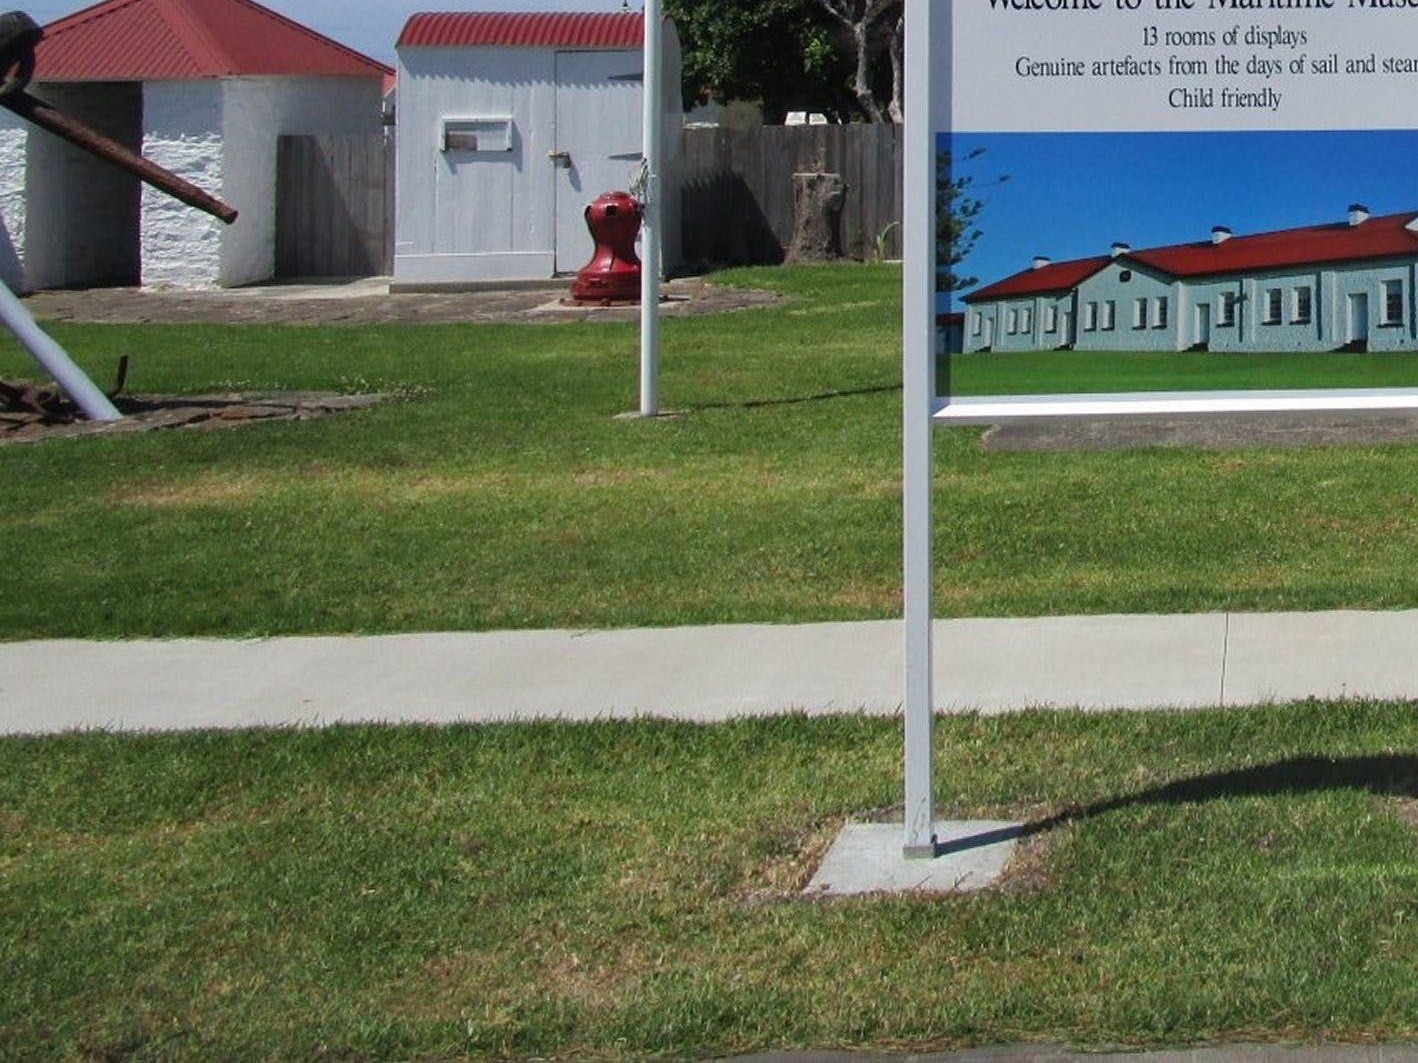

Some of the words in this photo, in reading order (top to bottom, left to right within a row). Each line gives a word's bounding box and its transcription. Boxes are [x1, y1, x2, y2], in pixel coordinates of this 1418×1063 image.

[1142, 26, 1158, 47] 13
[1165, 30, 1216, 46] rooms
[1222, 25, 1241, 47] of
[1244, 25, 1308, 50] displays
[1015, 57, 1085, 77] Genuine
[1092, 55, 1161, 77] artefacts
[1168, 55, 1207, 76] from
[1214, 54, 1240, 75] the
[1246, 54, 1282, 79] days
[1288, 53, 1307, 75] of
[1311, 53, 1338, 74] sail
[1345, 53, 1375, 74] and
[1168, 87, 1214, 109] Child
[1221, 86, 1283, 112] friendly
